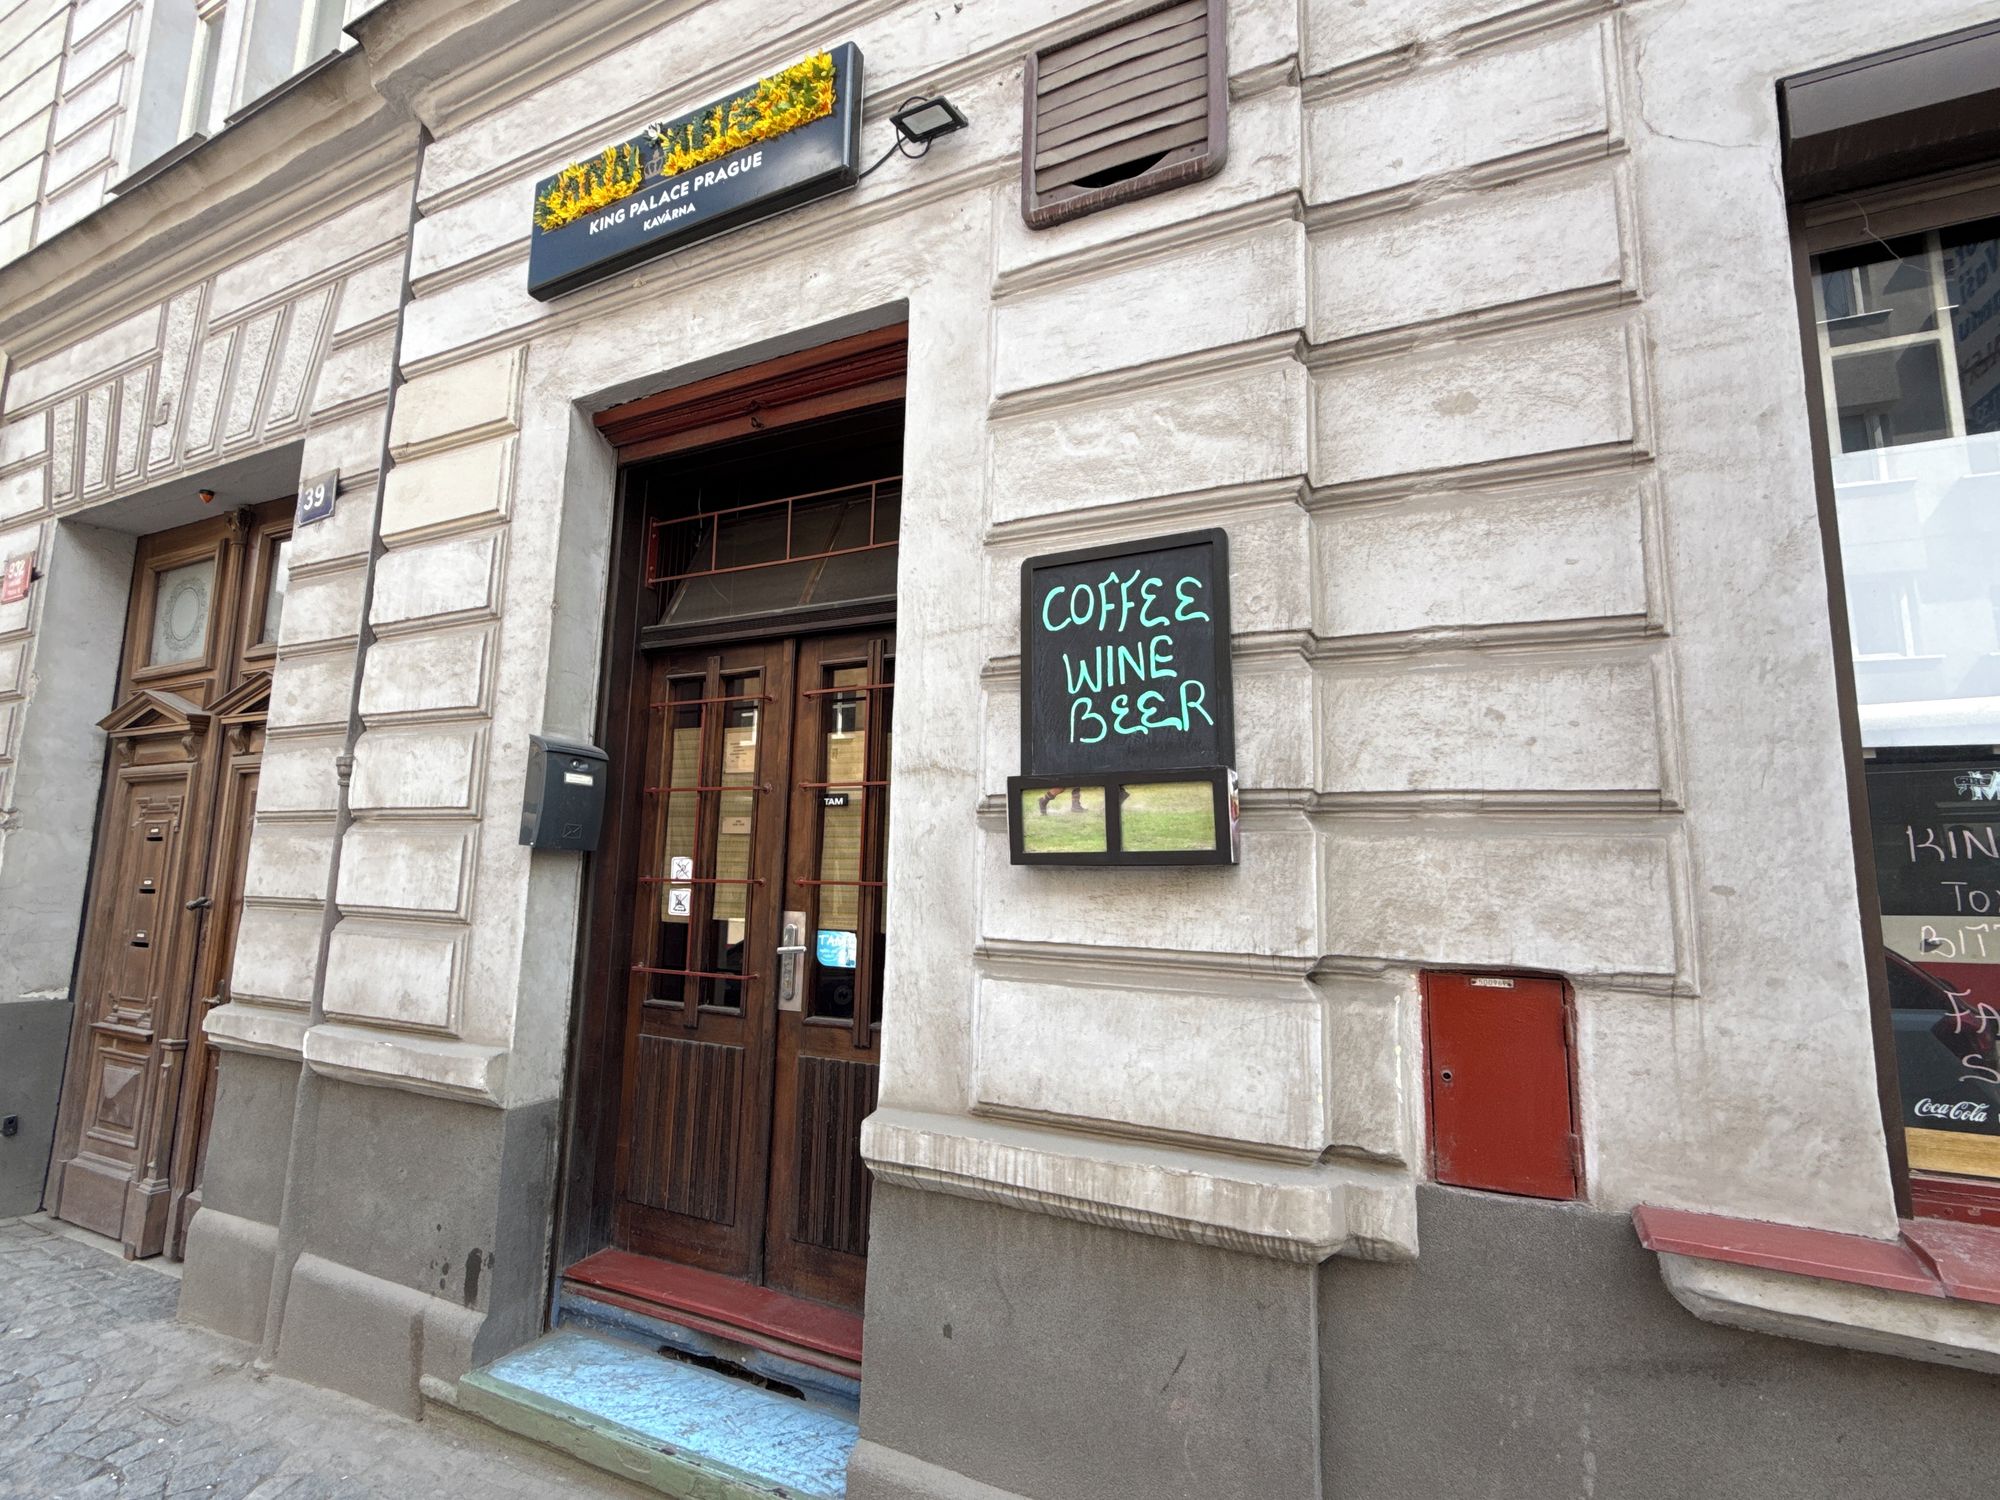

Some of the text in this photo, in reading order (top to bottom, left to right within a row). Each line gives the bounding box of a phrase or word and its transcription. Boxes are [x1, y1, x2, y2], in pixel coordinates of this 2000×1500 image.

[589, 150, 763, 236] KING PALACE PRAGUE
[643, 202, 696, 231] KAVÁRNA
[303, 484, 325, 511] 39
[1042, 569, 1210, 632] COFFEE
[1063, 634, 1178, 695] WINE
[1069, 679, 1215, 744] BEER
[823, 796, 844, 806] TAM
[1905, 824, 1999, 863] KIN
[1940, 880, 2000, 914] TO
[1943, 988, 2000, 1036] FA
[1914, 1098, 1990, 1122] Coca-Cola
